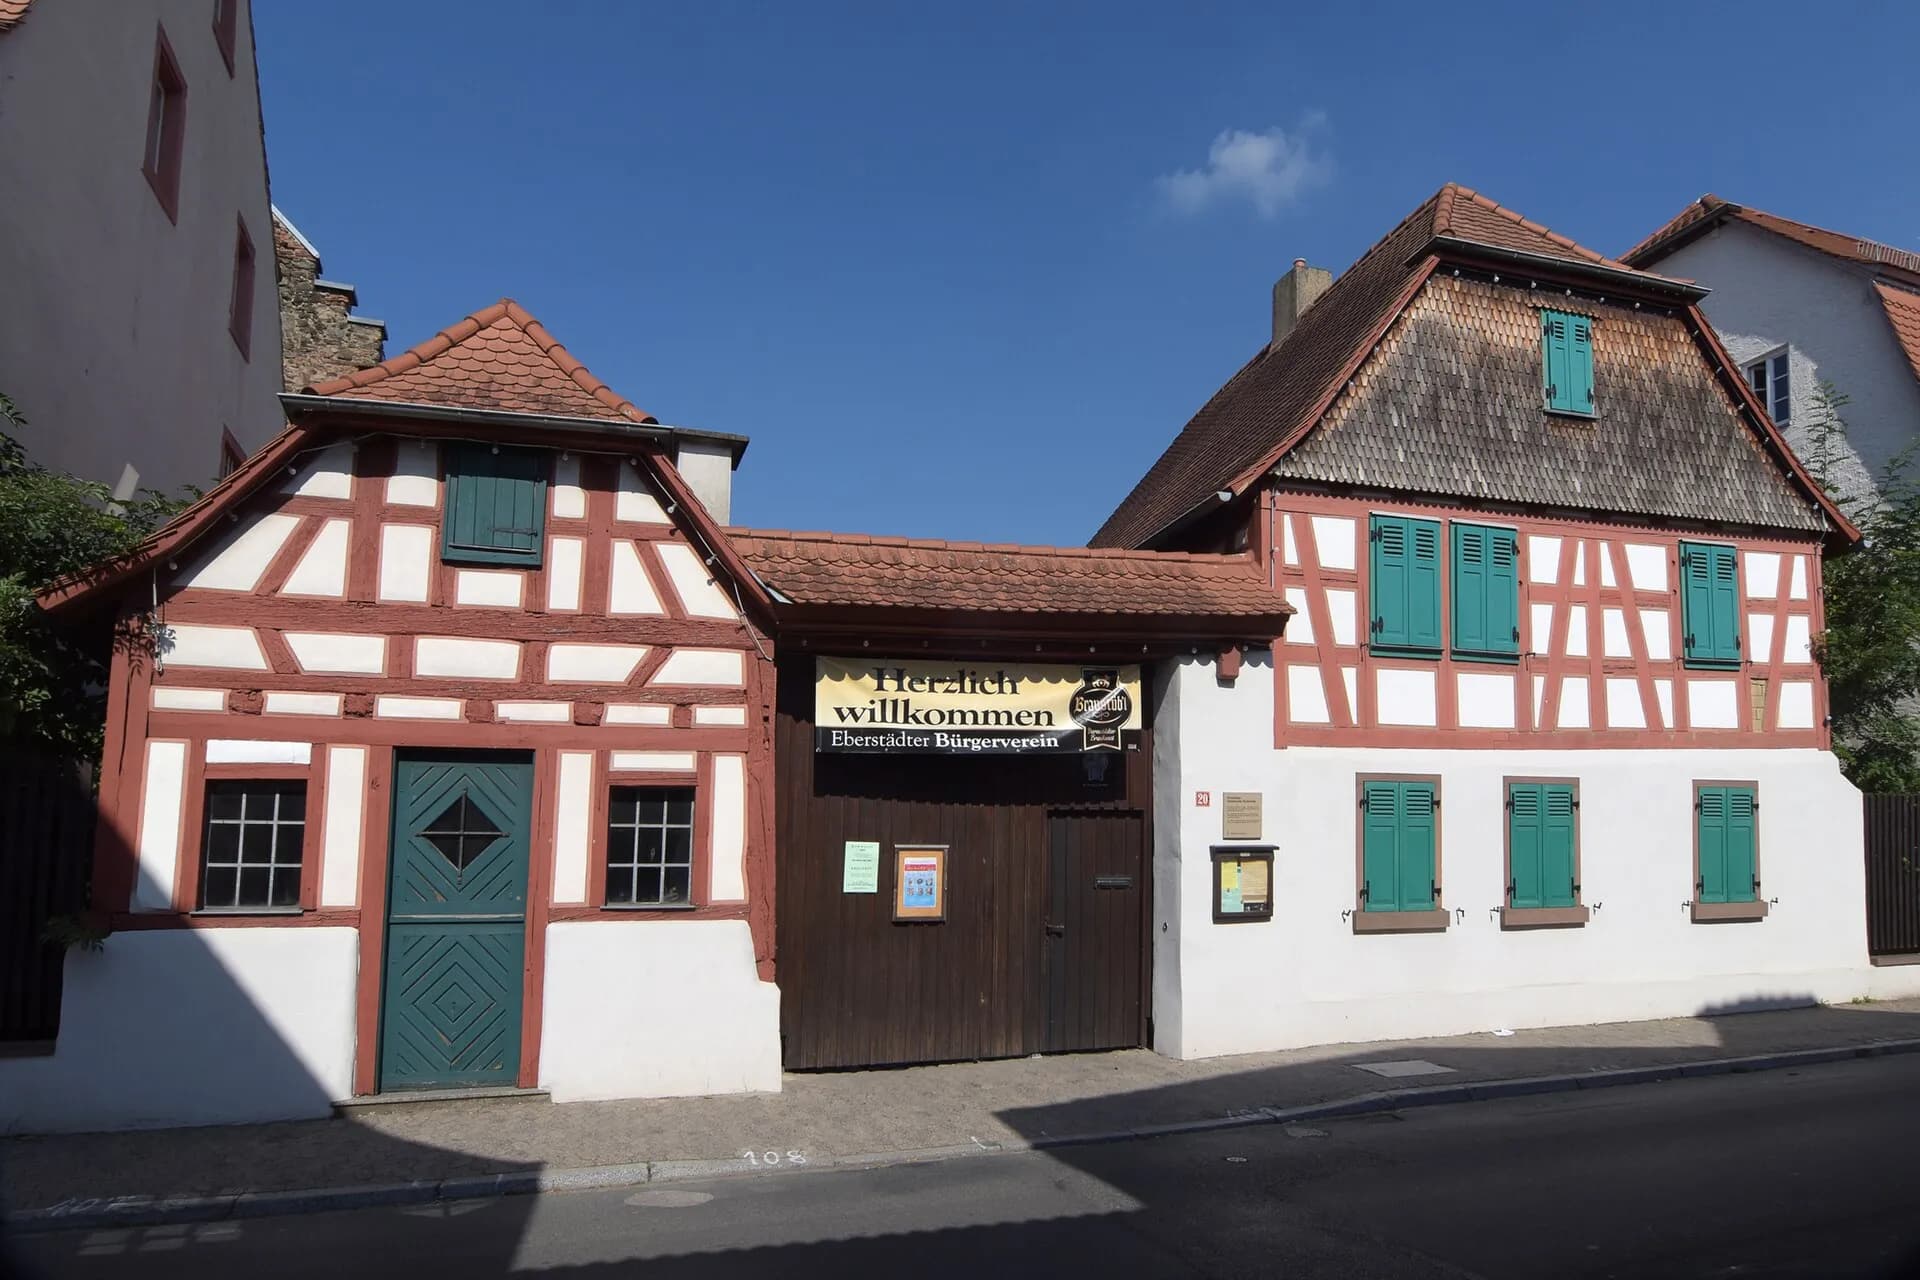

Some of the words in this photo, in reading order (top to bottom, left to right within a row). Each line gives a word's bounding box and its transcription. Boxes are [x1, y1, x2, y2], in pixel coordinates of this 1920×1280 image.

[872, 667, 1020, 694] Herzlich
[833, 698, 1055, 726] willkommen
[831, 730, 930, 747] Eberstädter
[934, 732, 1059, 751] Bürgerverein
[1197, 793, 1208, 805] 20
[743, 1150, 806, 1165] 108
